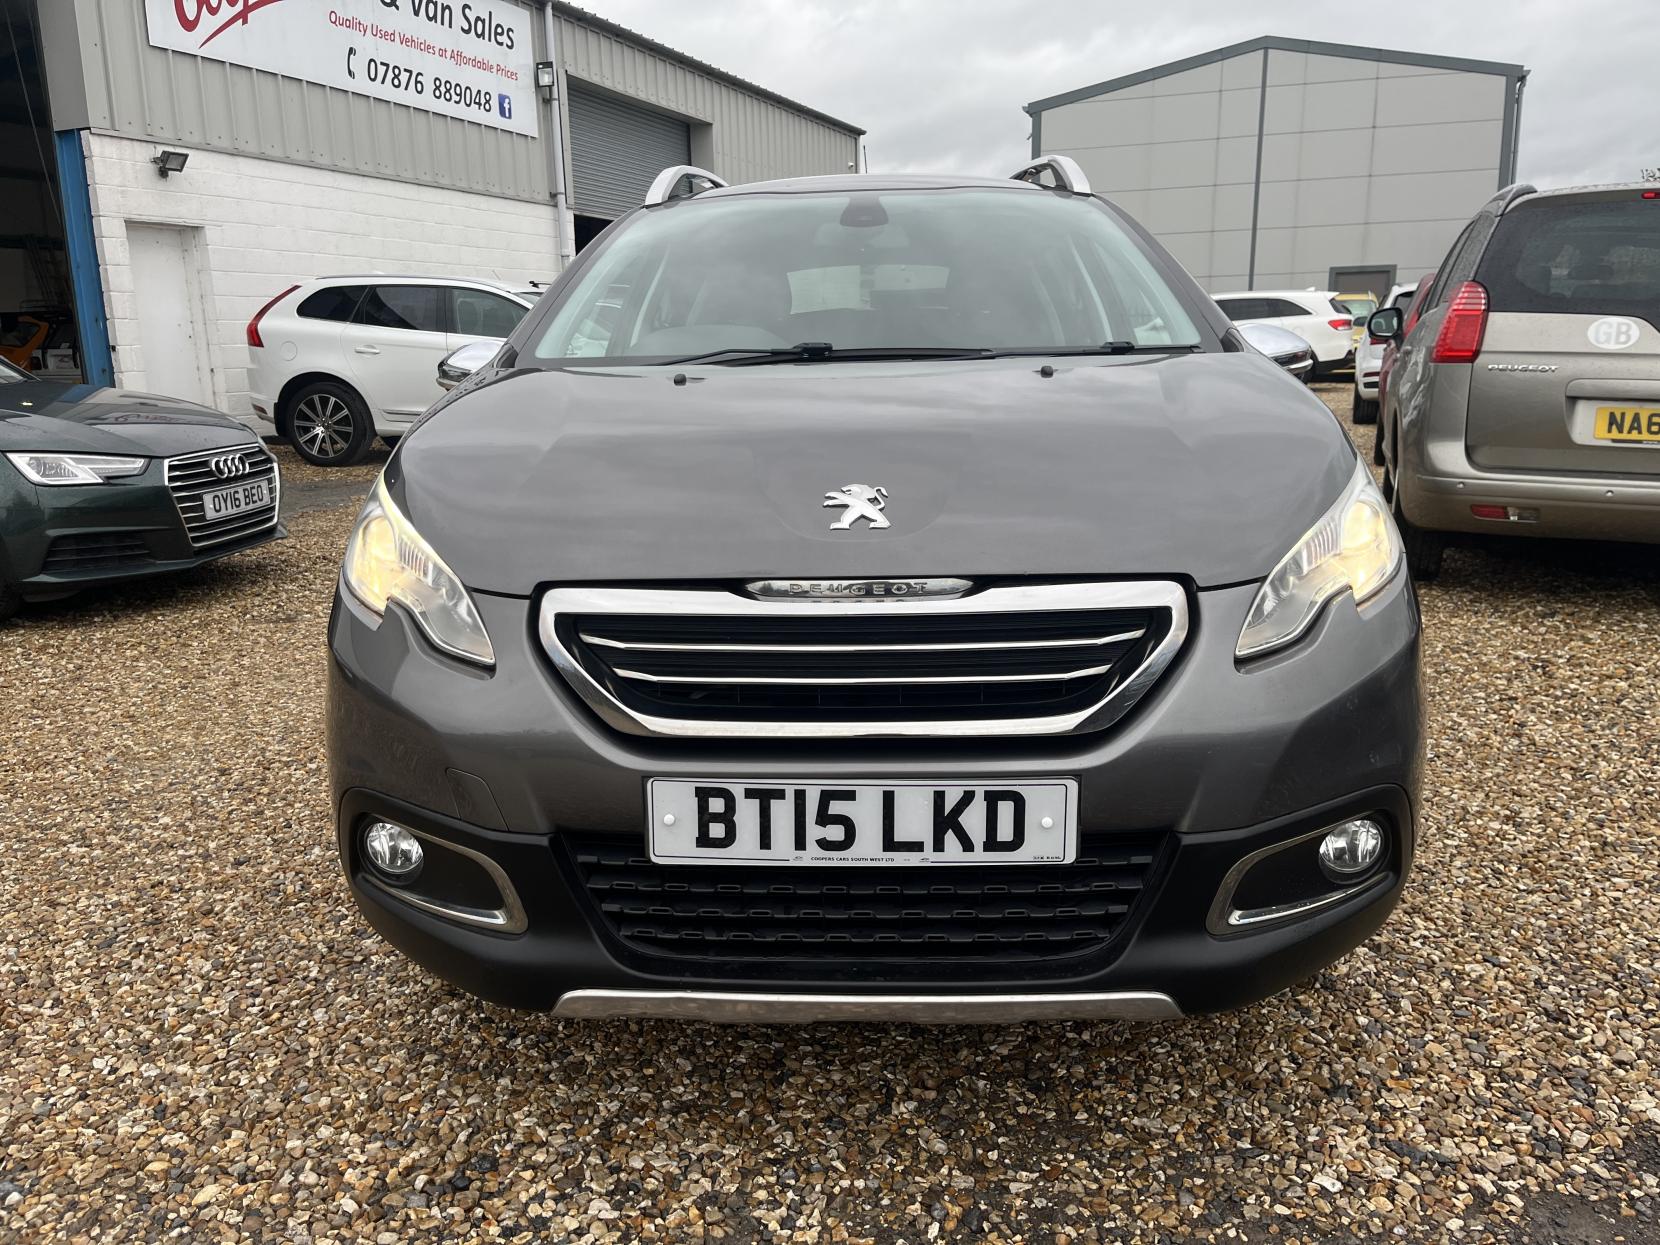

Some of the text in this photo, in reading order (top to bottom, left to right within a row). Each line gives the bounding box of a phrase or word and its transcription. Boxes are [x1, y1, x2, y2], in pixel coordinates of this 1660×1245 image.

[411, 0, 515, 50] Van Sales
[328, 10, 519, 81] Quality Used Vehicles at Affordable Prices
[367, 58, 492, 113] 07876 889048
[1594, 320, 1633, 346] GB
[1487, 364, 1561, 373] PEUGEOT
[212, 484, 264, 513] OY16 BEO
[788, 581, 928, 595] PEUGEOT
[694, 786, 1027, 853] BT15 LKD
